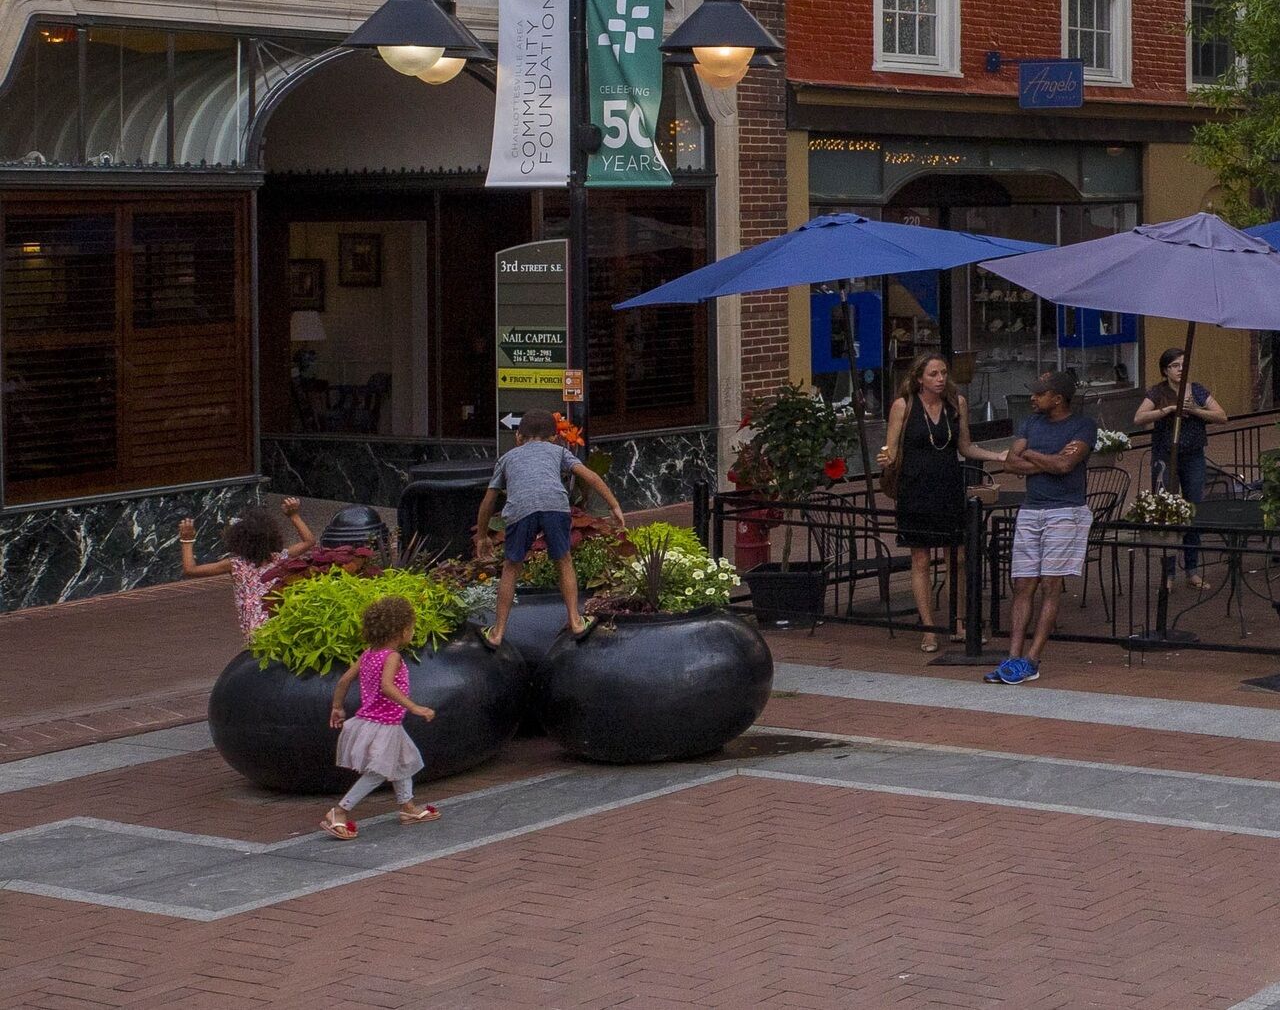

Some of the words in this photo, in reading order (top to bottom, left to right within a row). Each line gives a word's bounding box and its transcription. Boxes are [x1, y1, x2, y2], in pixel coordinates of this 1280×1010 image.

[516, 20, 524, 49] AREA
[1023, 66, 1077, 104] Angelo
[520, 19, 539, 175] COMMUNITY
[601, 154, 664, 172] YEARS
[904, 216, 921, 226] 220
[500, 260, 518, 272] 3rd
[520, 264, 548, 272] STREET
[550, 263, 564, 272] S.E.
[502, 333, 524, 343] NAIL
[525, 333, 563, 344] CAPITAL
[509, 376, 533, 384] FRONT
[540, 376, 563, 384] PORCH
